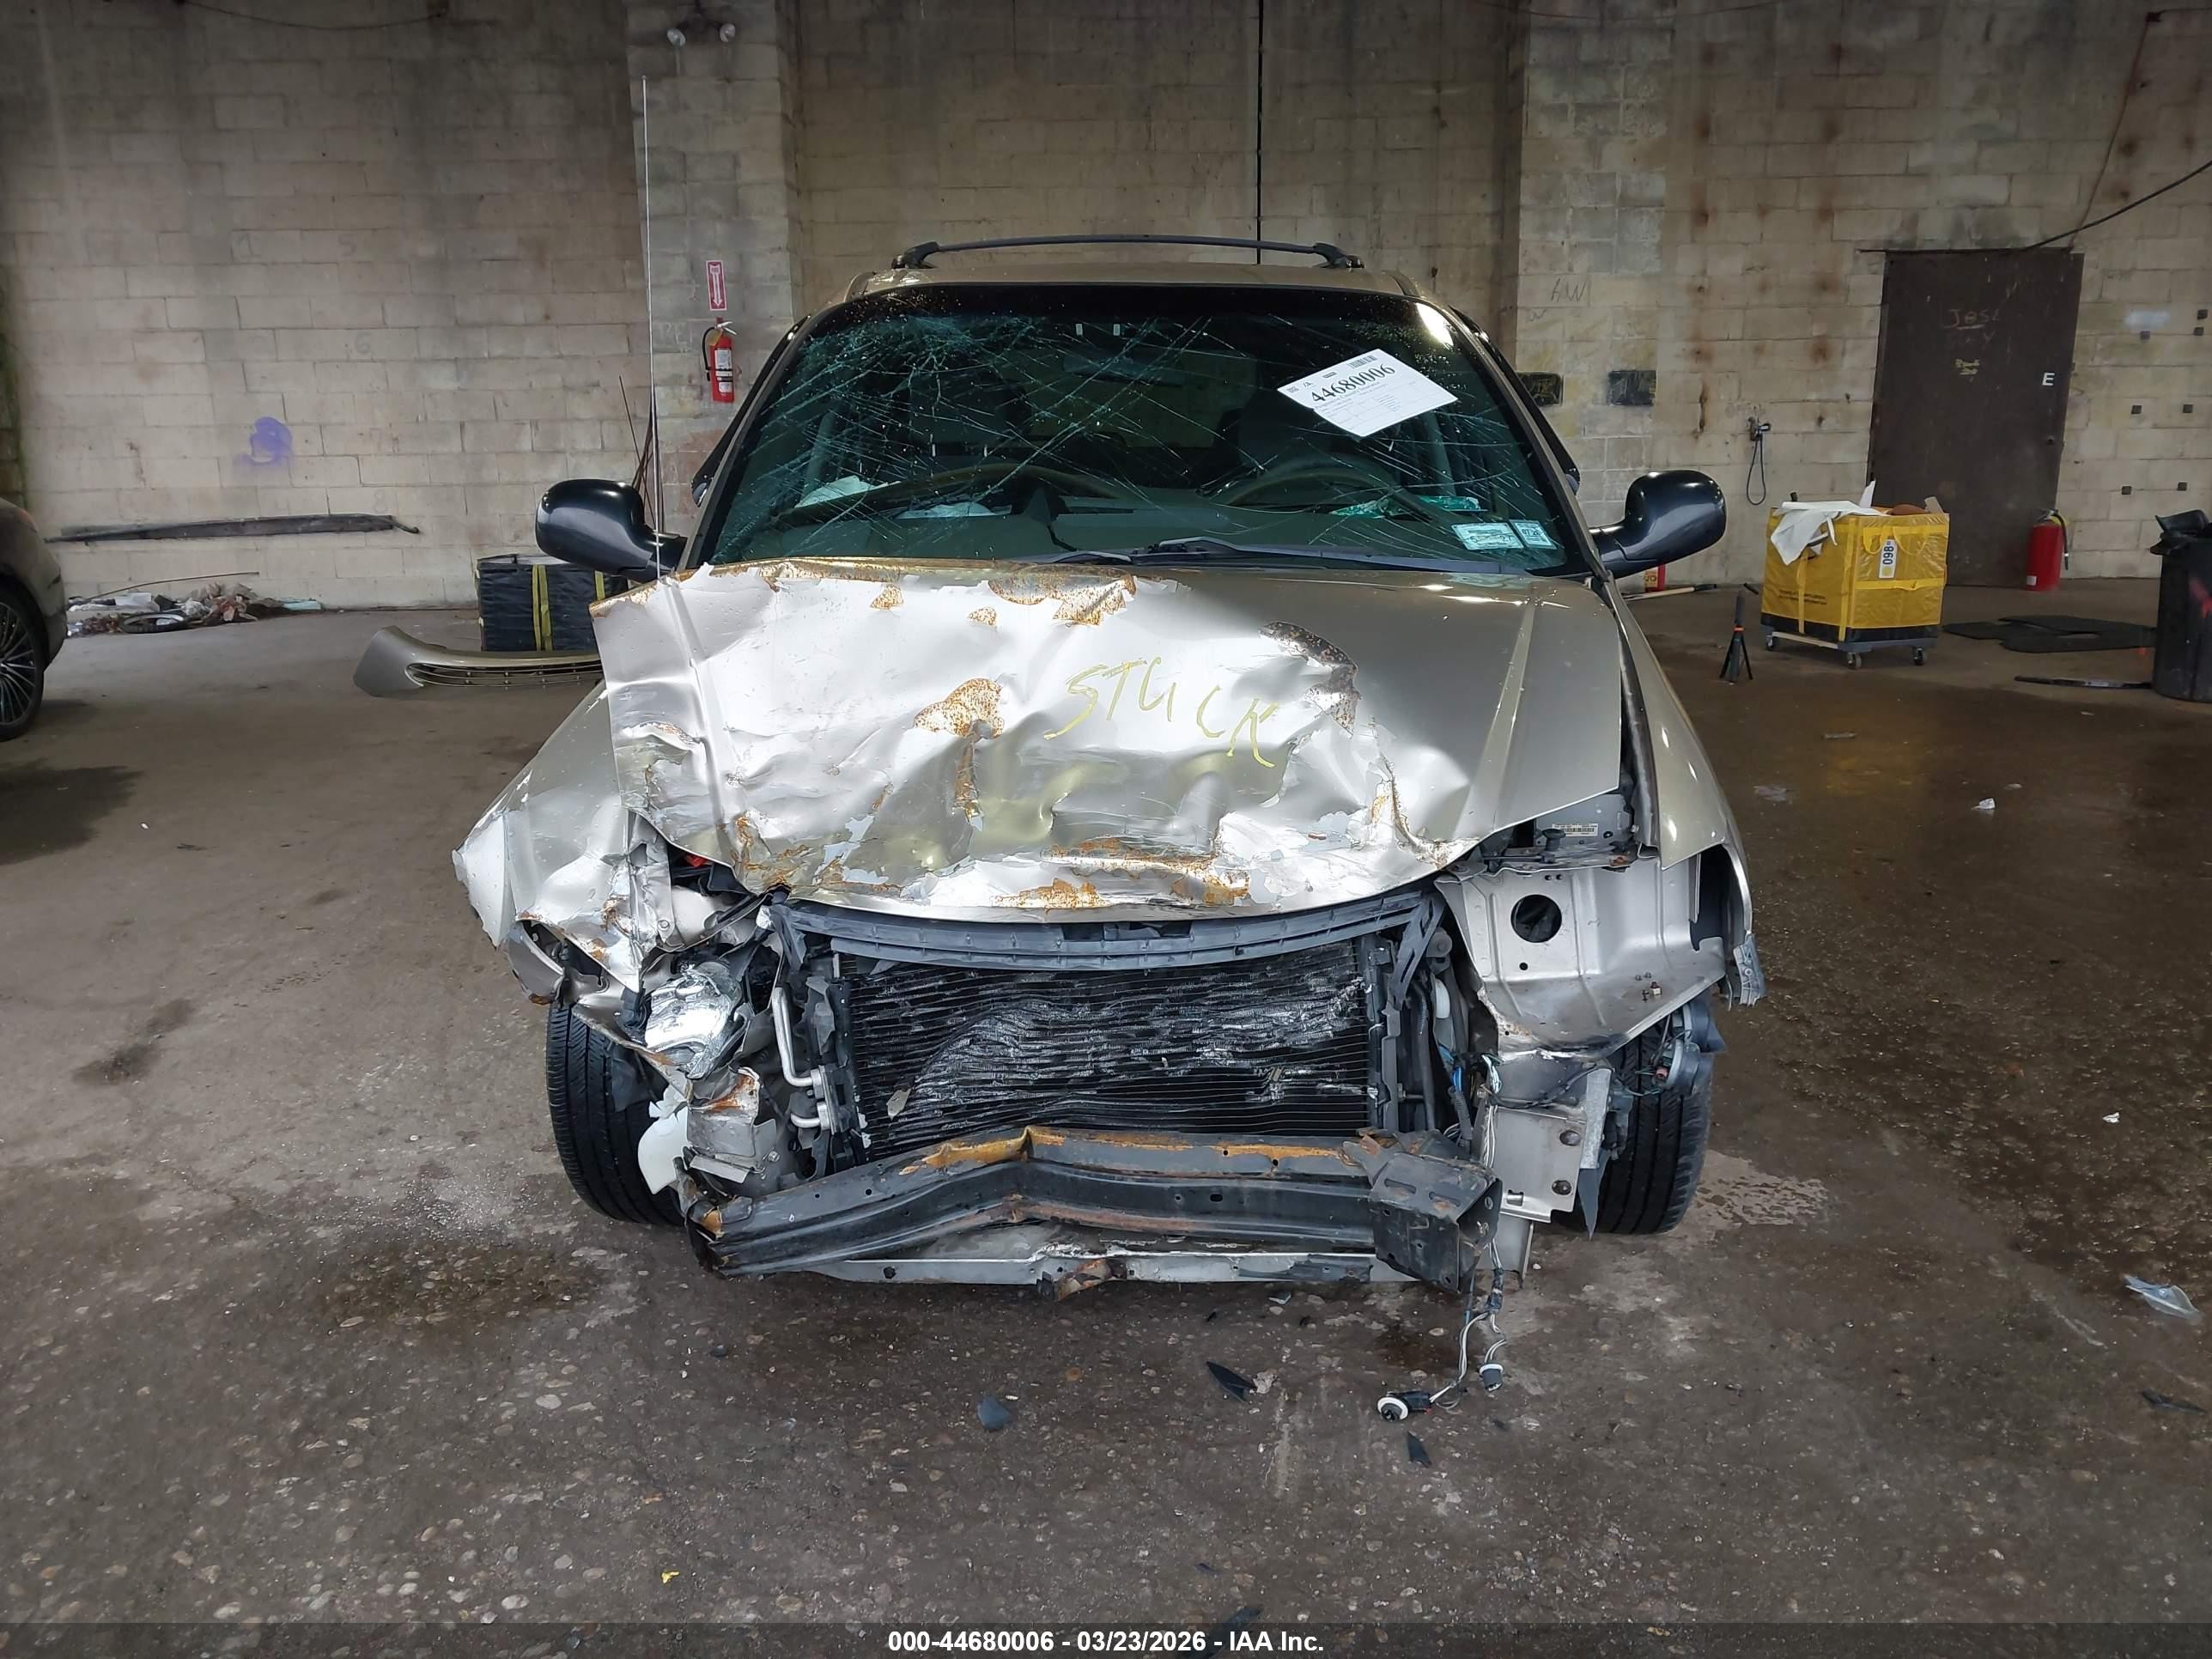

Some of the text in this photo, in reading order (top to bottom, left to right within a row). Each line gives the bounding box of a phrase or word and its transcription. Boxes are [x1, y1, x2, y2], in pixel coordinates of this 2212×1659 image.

[1311, 363, 1395, 402] 44680006
[2042, 372, 2055, 386] E
[1044, 656, 1279, 768] STUCK
